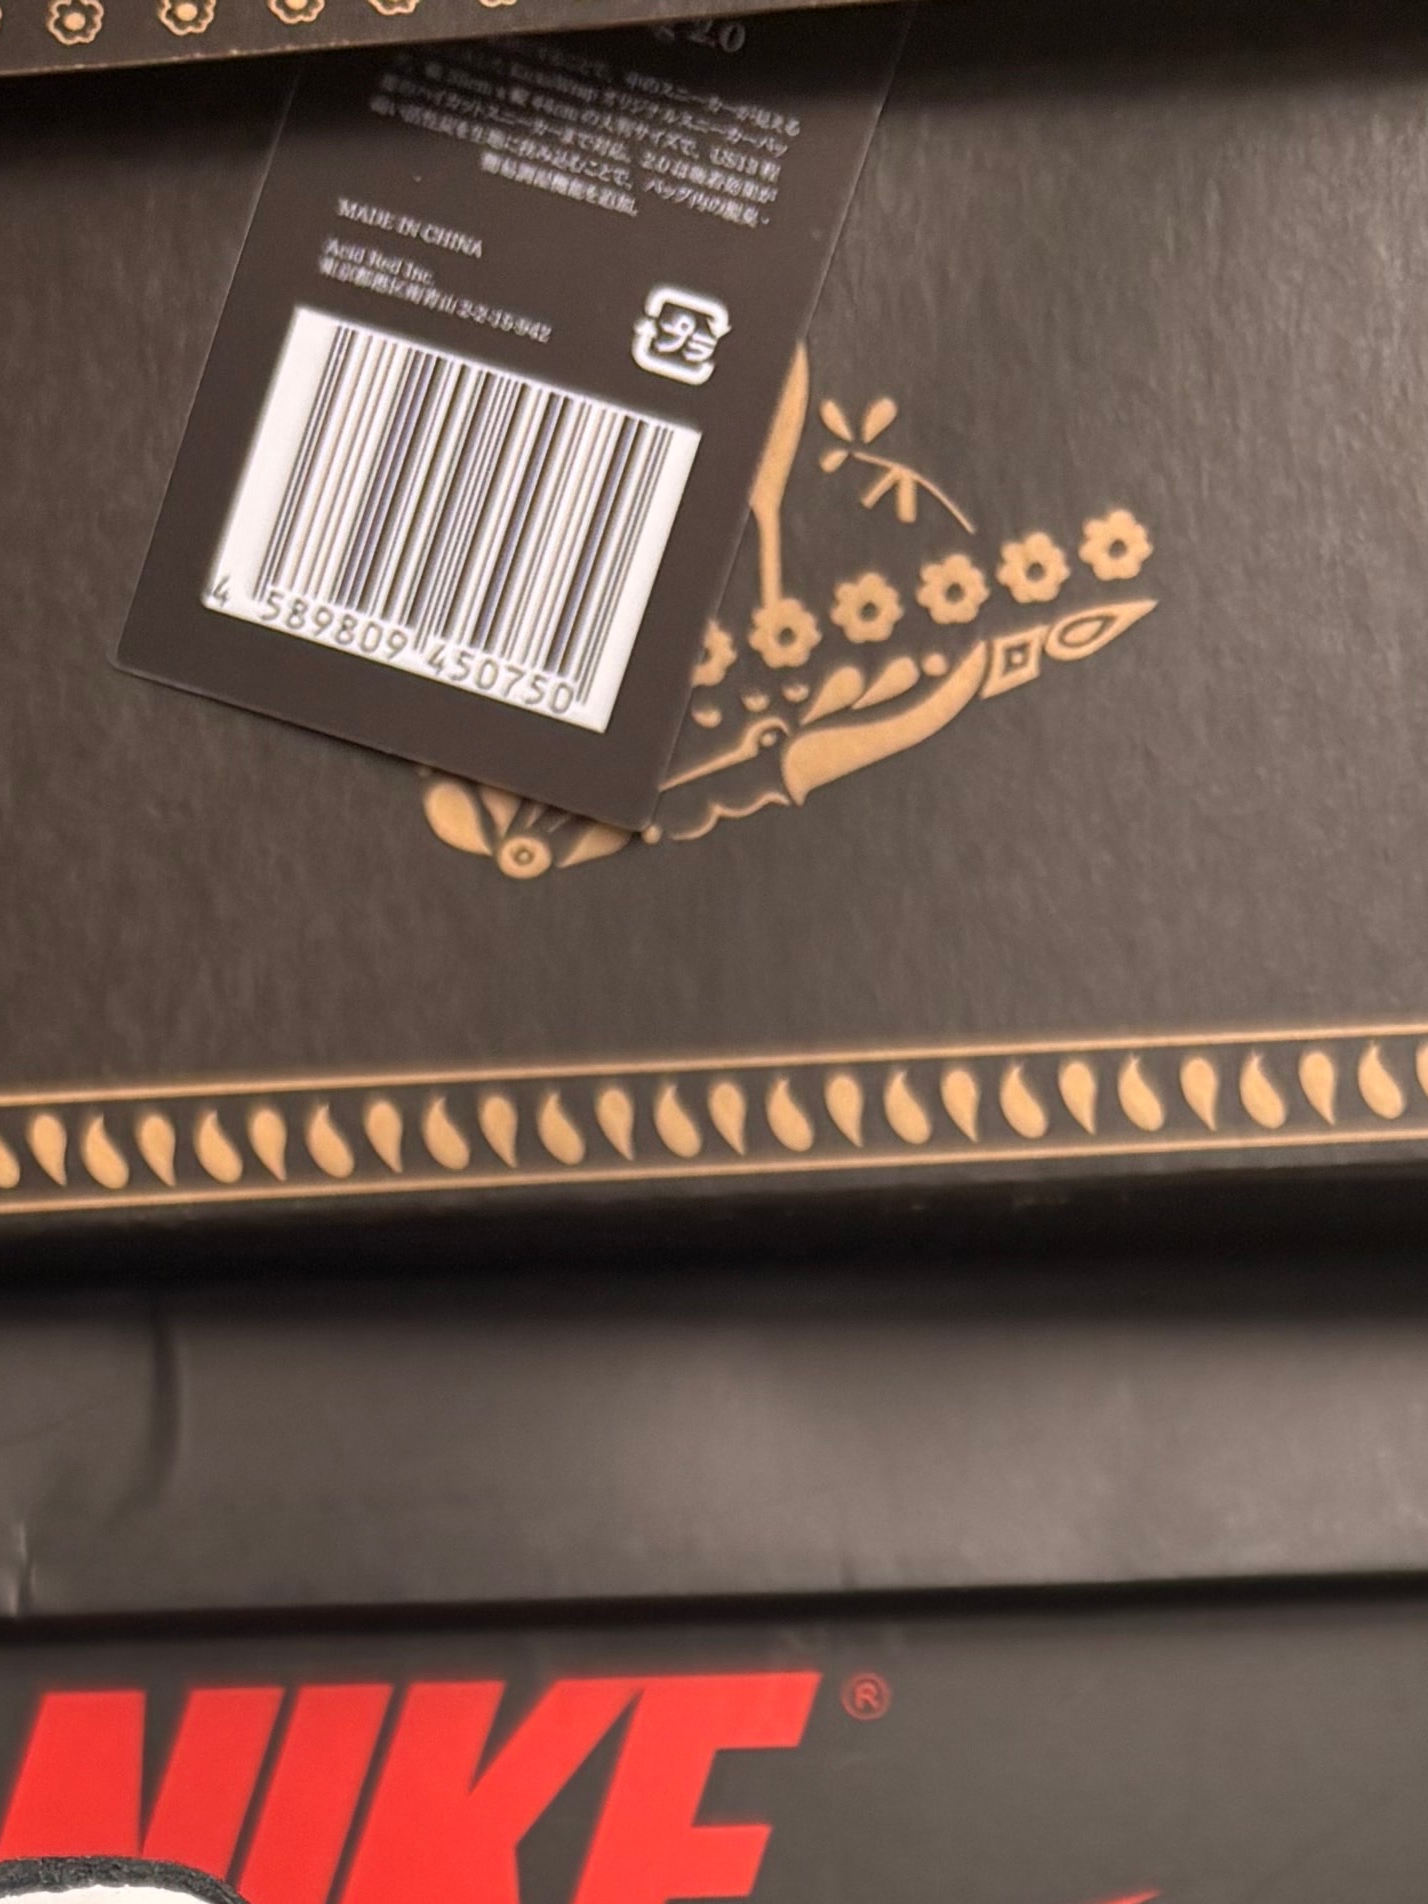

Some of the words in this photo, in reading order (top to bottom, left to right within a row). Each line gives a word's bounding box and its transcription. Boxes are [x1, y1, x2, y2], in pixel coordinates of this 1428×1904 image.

[209, 575, 230, 608] 4
[259, 588, 408, 660] 589809
[426, 643, 573, 714] 450750
